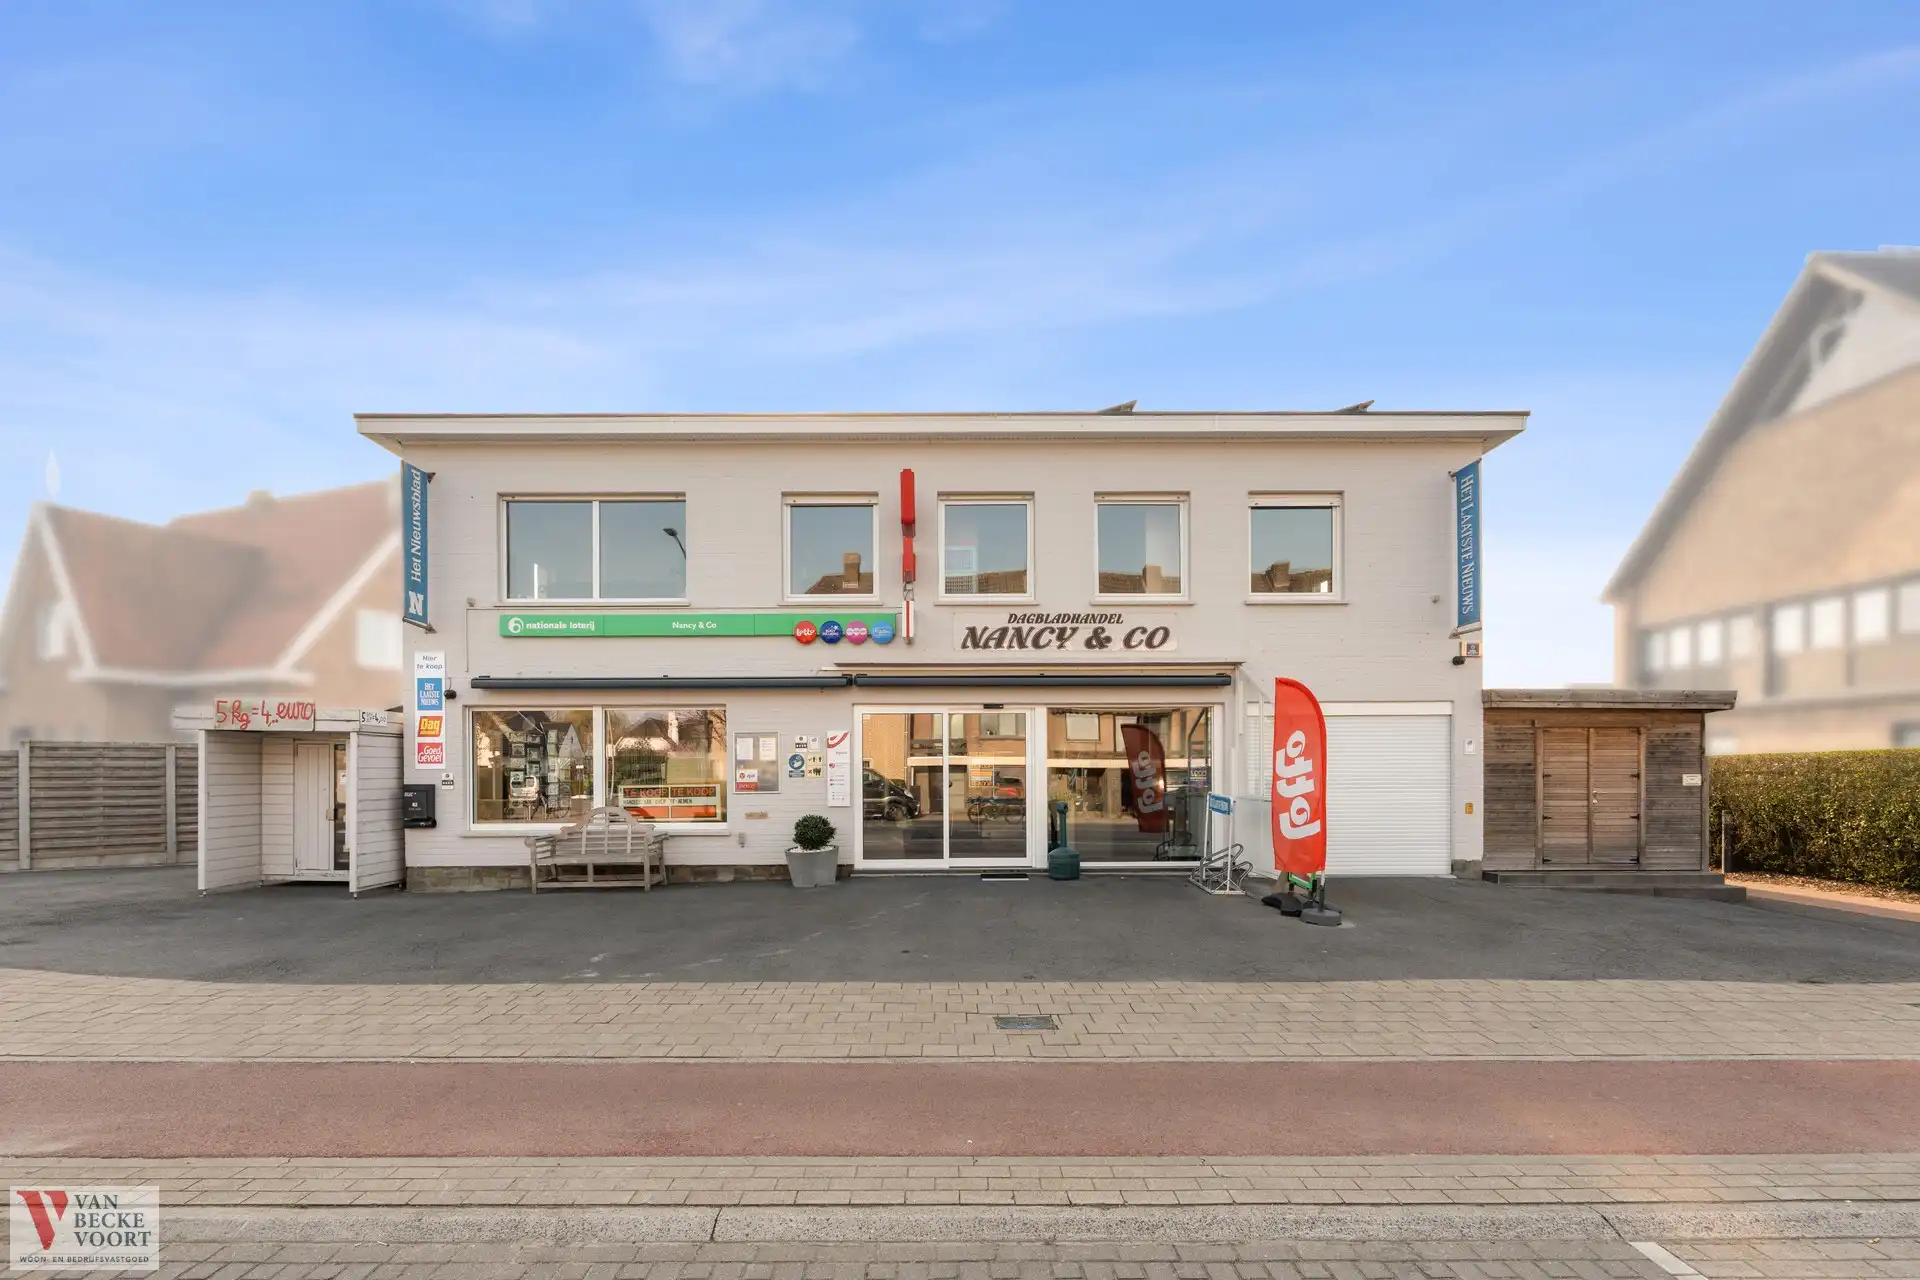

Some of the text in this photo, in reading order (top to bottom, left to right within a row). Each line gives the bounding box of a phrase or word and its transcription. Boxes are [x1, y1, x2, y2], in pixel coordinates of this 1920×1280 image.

[410, 468, 422, 582] Het Nieuwsblad
[1462, 561, 1475, 614] NIEUWS
[408, 590, 424, 616] N
[526, 620, 595, 632] nationale loterij
[672, 621, 696, 630] Nancy
[1008, 613, 1124, 624] DAGBLADHANDEL
[961, 626, 1170, 650] NANCY & CO
[216, 700, 228, 723] 5
[672, 787, 715, 796] TE KOOP
